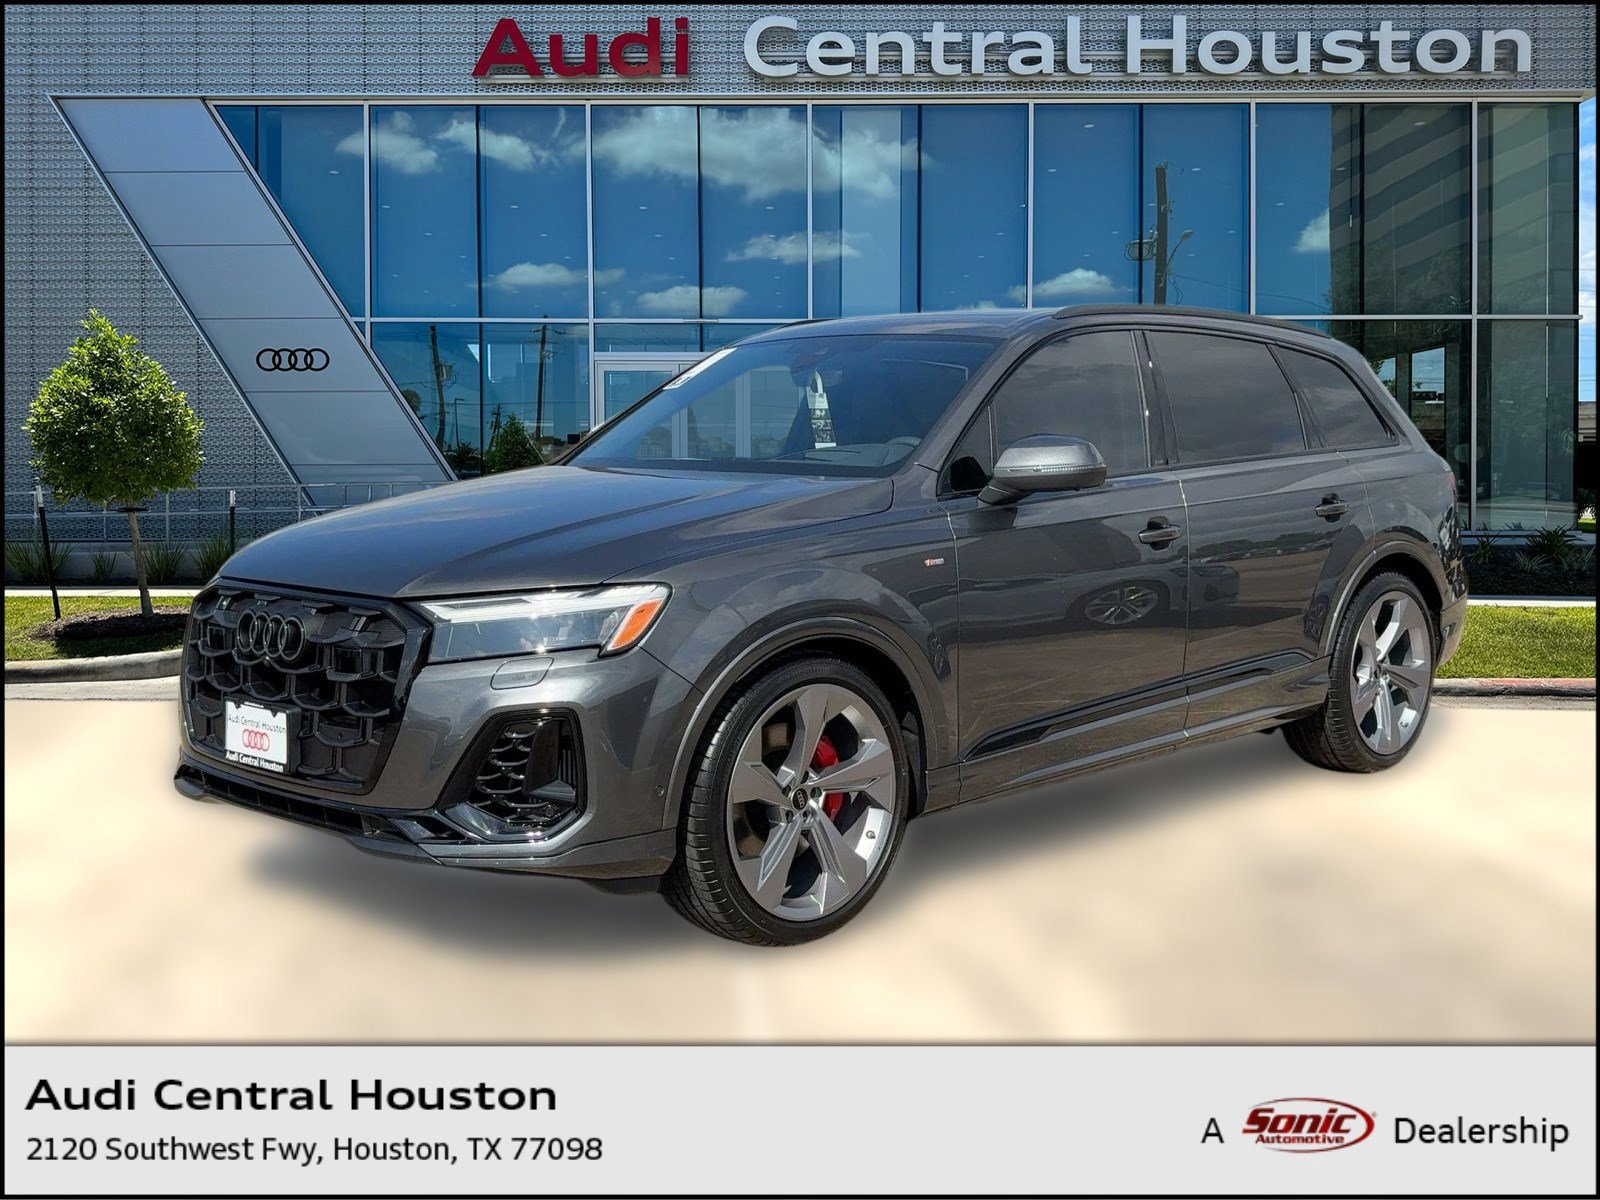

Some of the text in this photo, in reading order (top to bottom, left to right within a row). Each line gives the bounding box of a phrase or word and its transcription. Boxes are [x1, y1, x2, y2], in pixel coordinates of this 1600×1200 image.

[471, 15, 1531, 79] Audi Central Houston
[241, 716, 260, 729] Central
[262, 721, 286, 734] Houston
[226, 750, 284, 773] Audi Central Houston
